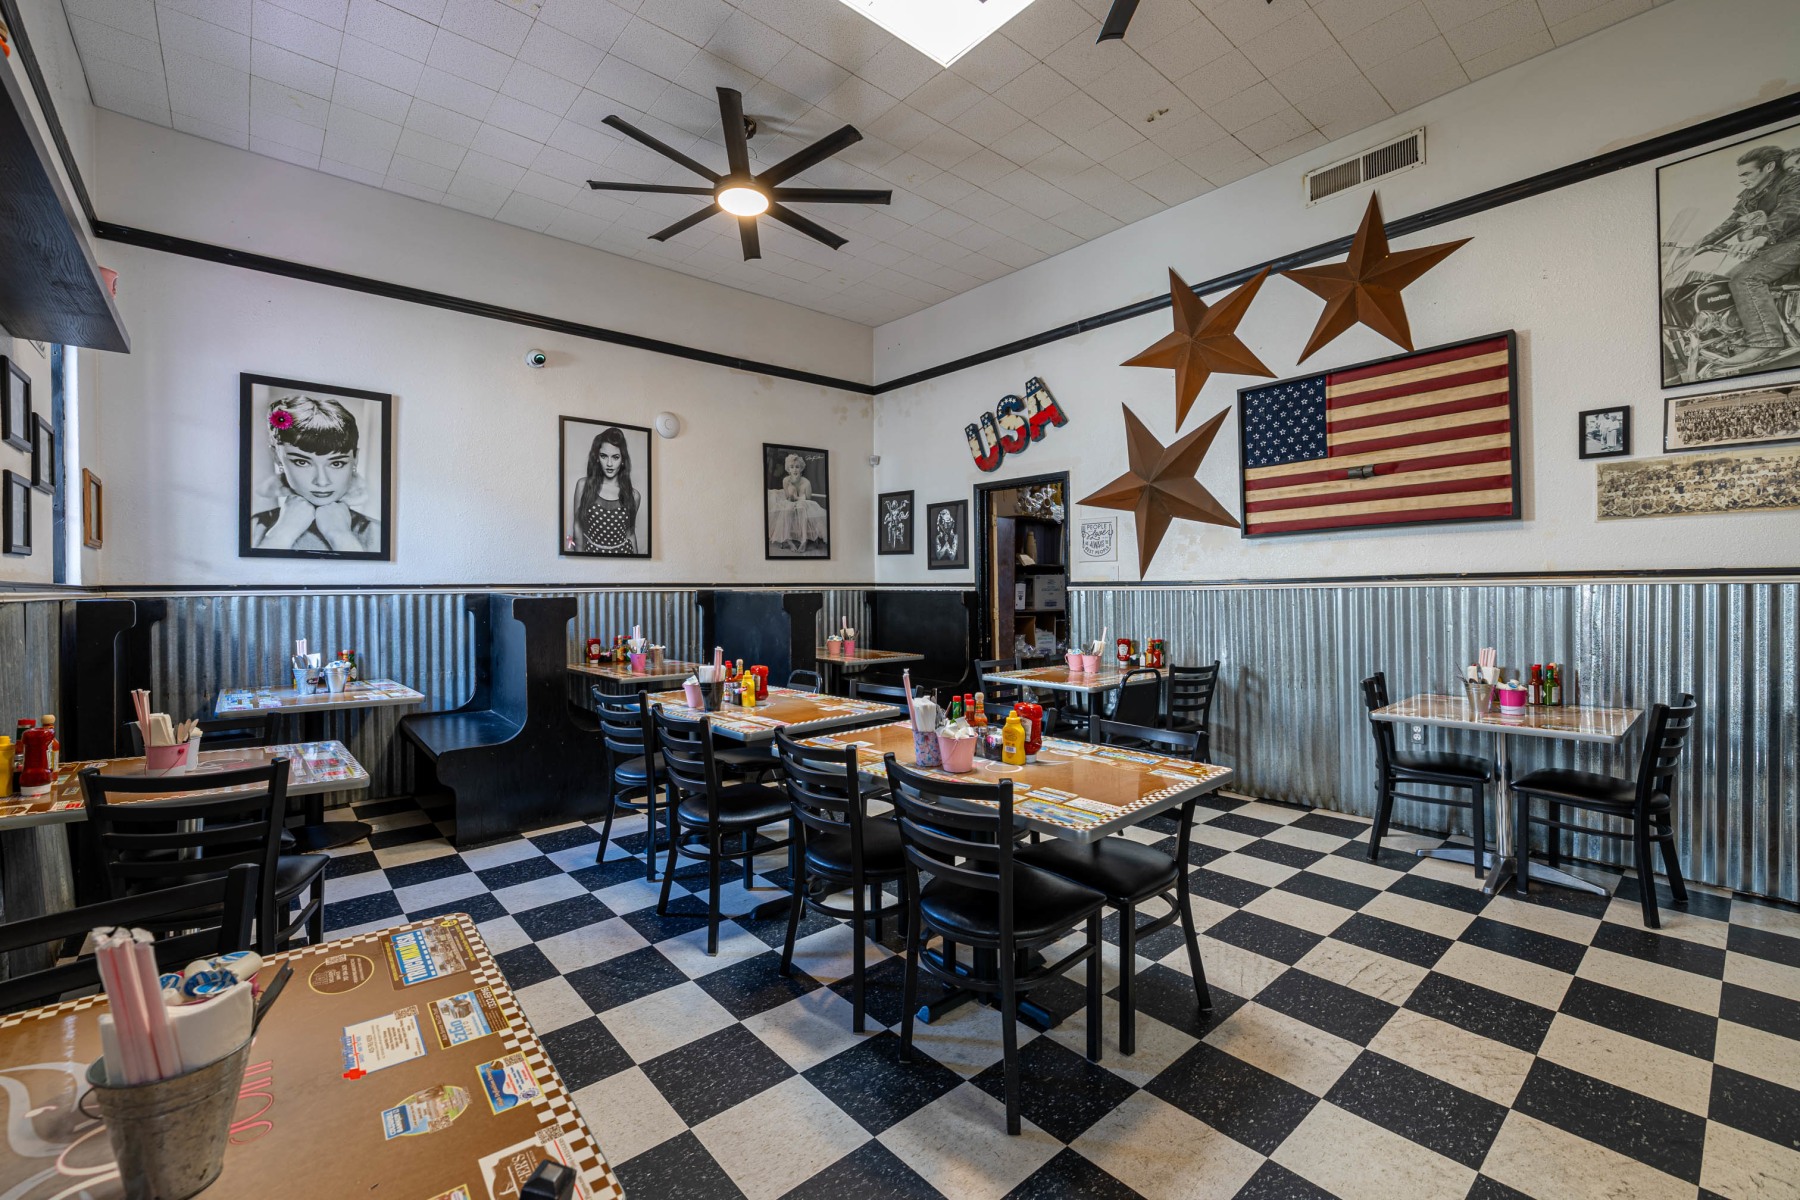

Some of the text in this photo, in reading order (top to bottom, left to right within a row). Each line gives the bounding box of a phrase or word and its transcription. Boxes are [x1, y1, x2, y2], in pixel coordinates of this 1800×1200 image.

[965, 376, 1068, 472] USA
[448, 1020, 469, 1044] EzGo
[463, 1020, 473, 1036] AUTO
